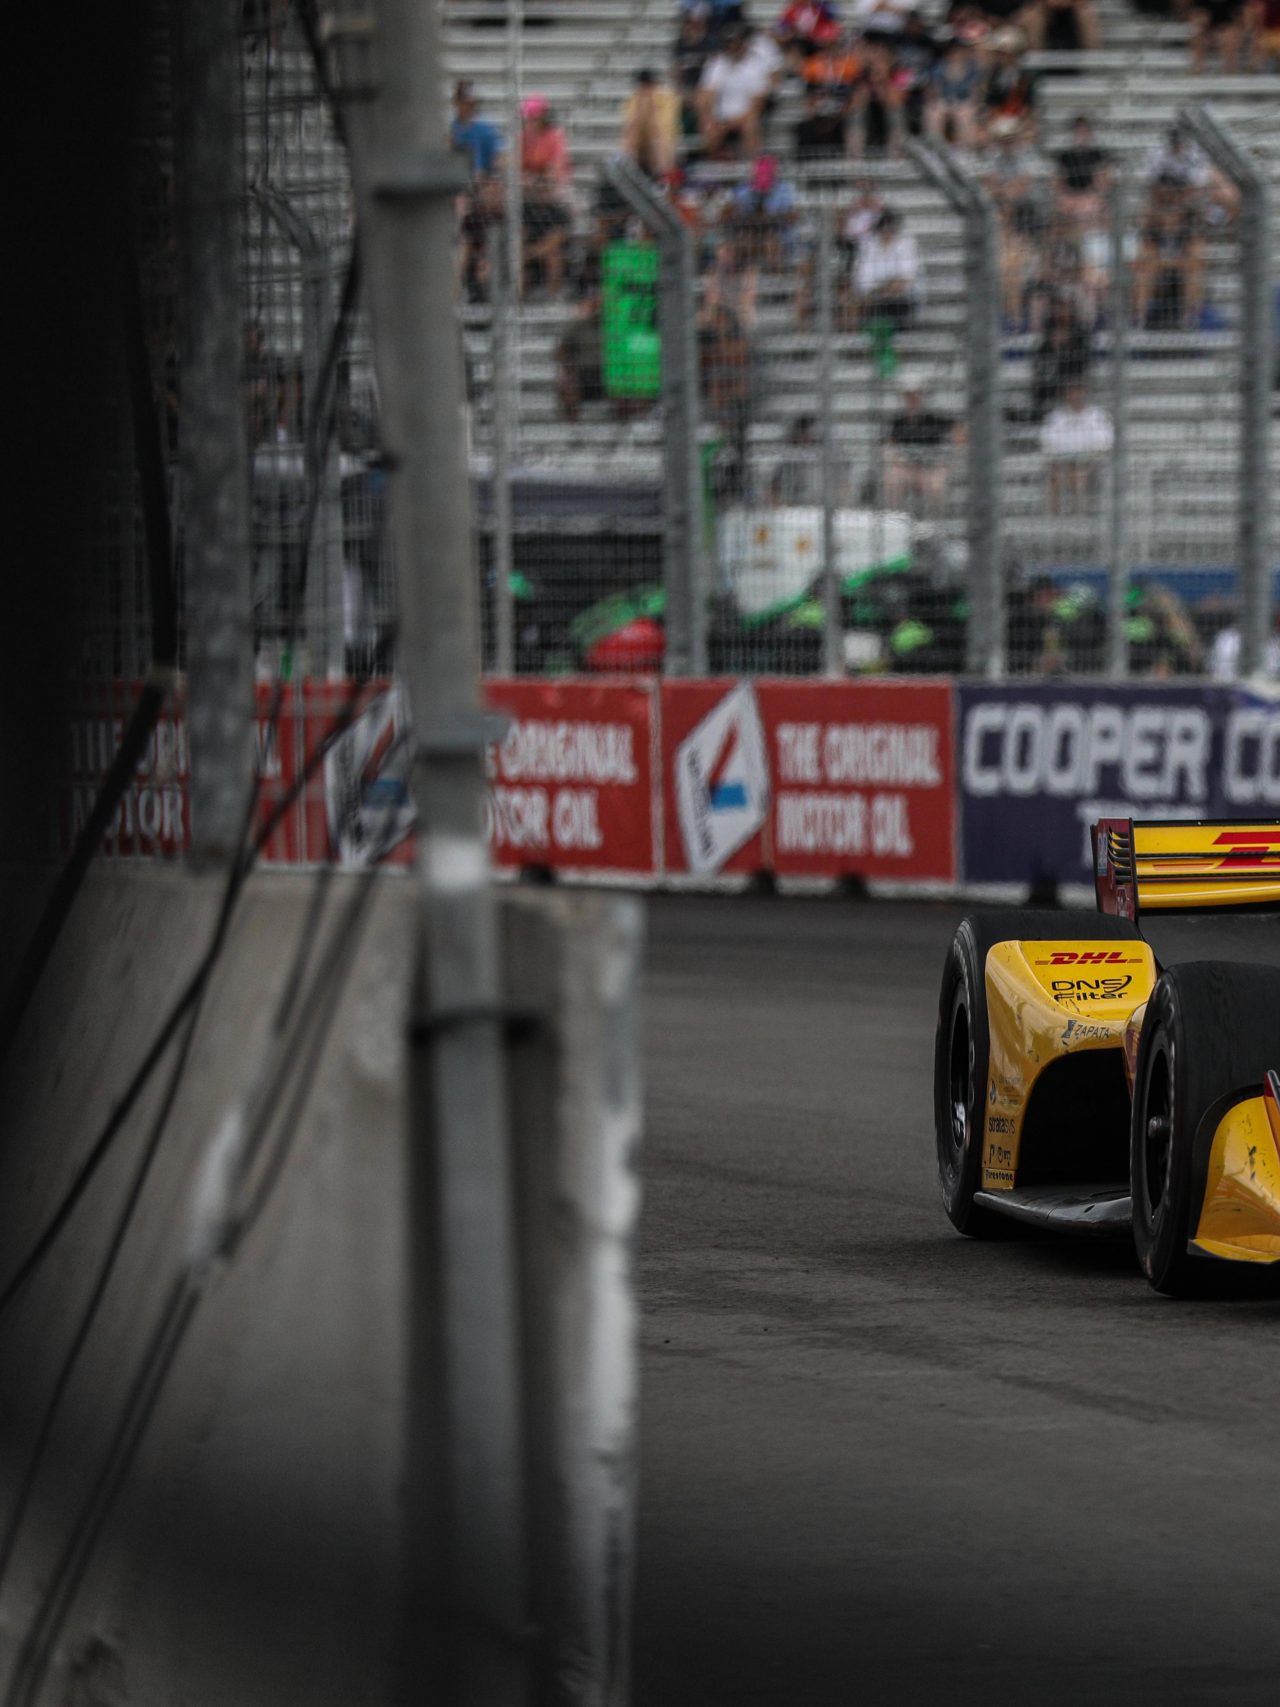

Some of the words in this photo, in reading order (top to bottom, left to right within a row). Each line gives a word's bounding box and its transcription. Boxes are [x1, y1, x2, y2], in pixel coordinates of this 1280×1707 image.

[775, 722, 820, 783] THE
[825, 722, 942, 789] ORIGINAL
[964, 703, 1211, 801] COOPER
[553, 787, 604, 850] OIL
[776, 791, 869, 855] MOTOR
[871, 793, 915, 858] OIL
[1049, 951, 1129, 966] DHL
[1051, 974, 1133, 994] DNS
[1053, 991, 1129, 1003] Filter
[1074, 1023, 1111, 1040] ZAPATA
